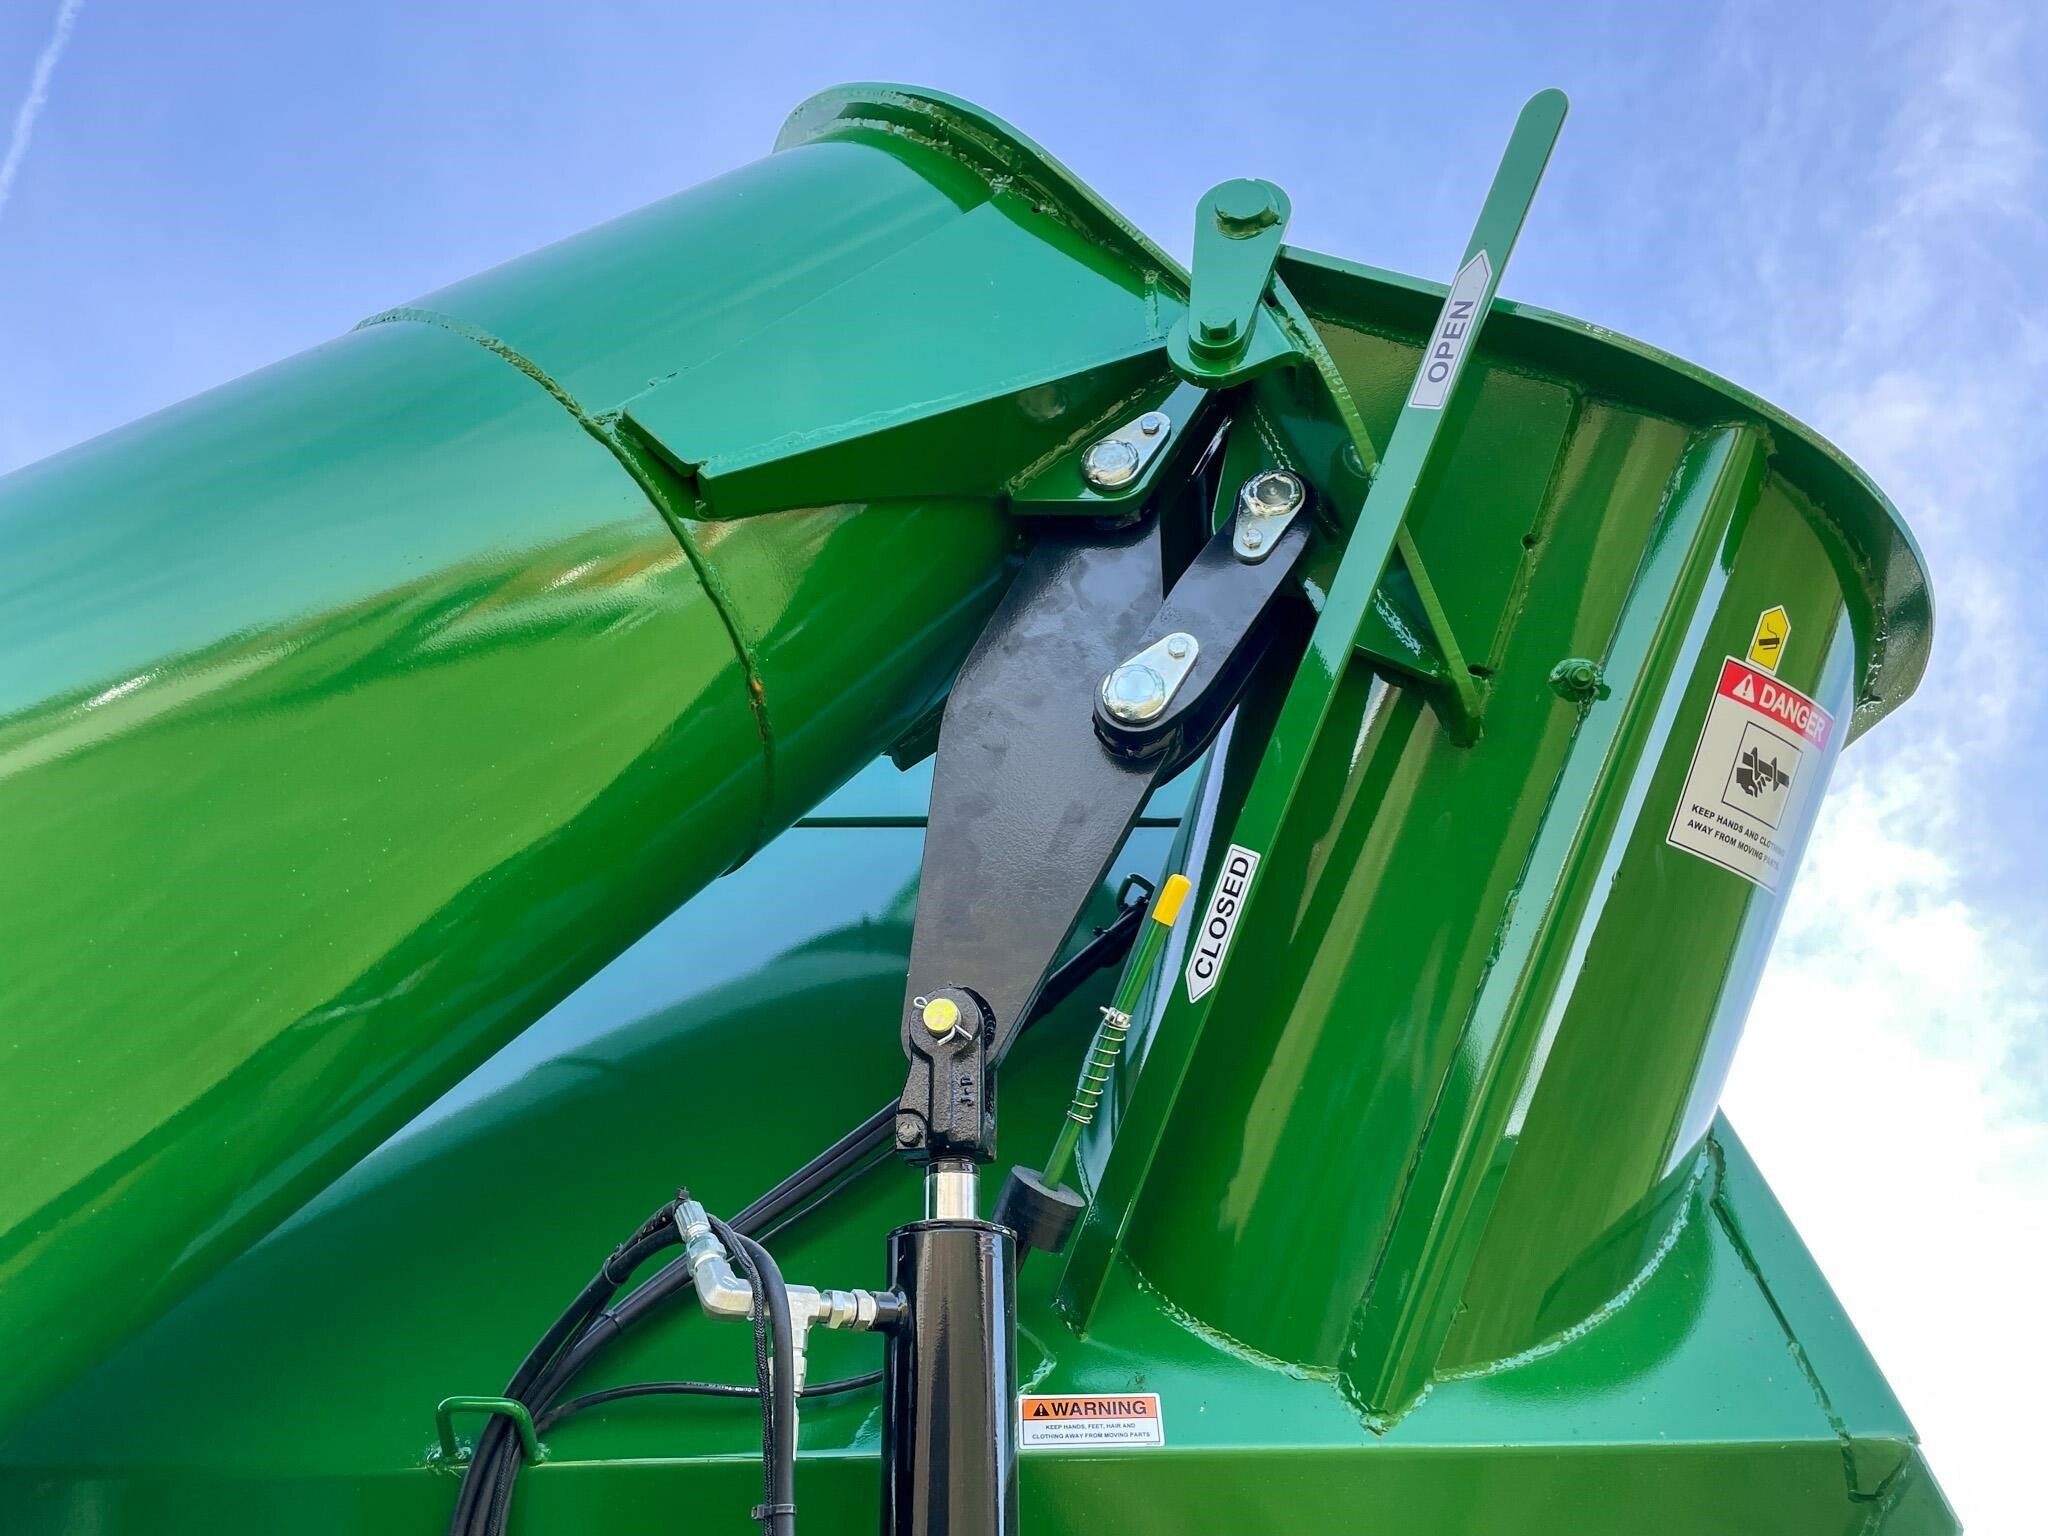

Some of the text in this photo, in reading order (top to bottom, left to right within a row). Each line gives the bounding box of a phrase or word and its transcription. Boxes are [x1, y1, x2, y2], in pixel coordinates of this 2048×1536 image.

[1427, 300, 1474, 383] OPEN
[1759, 683, 1826, 742] DANGER
[1687, 819, 1714, 835] AWAY
[1714, 830, 1737, 847] FROM
[1737, 841, 1764, 861] MOVING
[1691, 803, 1785, 857] KEEP HANDS AND CLOT
[1194, 857, 1249, 979] CLOSED
[1050, 1400, 1147, 1416] WARNING
